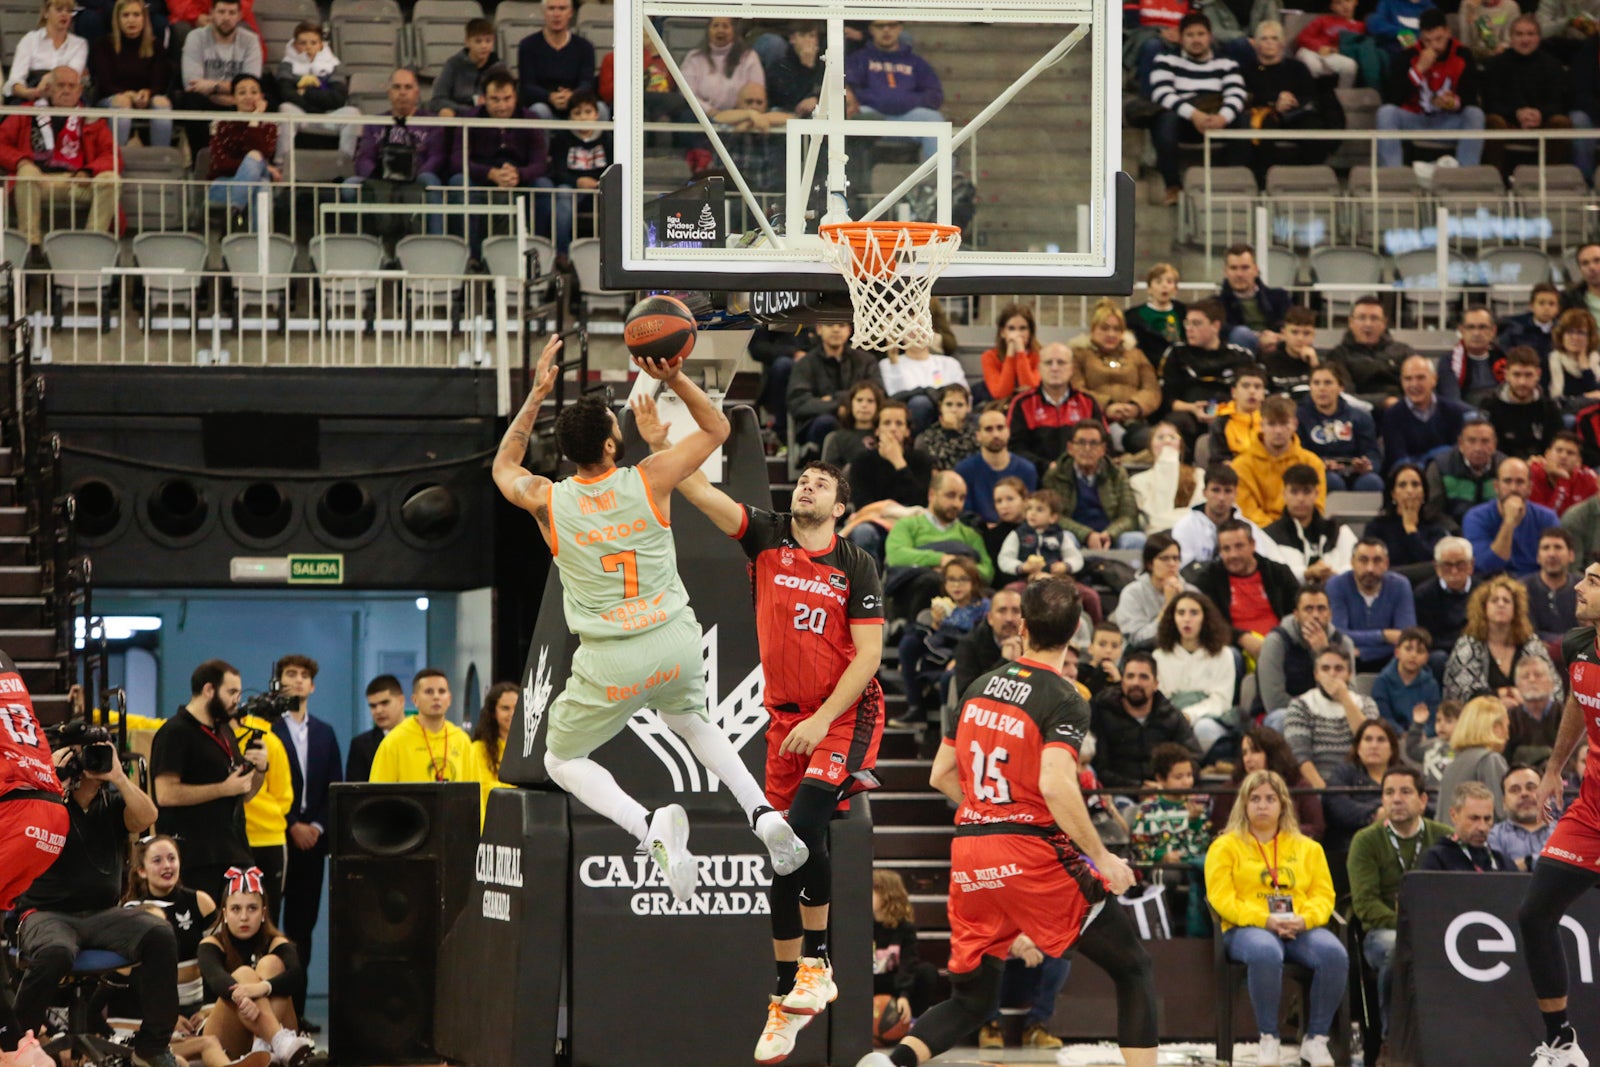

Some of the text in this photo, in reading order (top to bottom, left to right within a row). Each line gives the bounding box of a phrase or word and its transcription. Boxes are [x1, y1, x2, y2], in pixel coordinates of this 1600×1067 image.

[667, 228, 717, 240] Navidad
[575, 518, 648, 546] CAZOO
[292, 562, 338, 576] SALIDA
[600, 549, 639, 600] 7
[793, 602, 827, 635] 20
[0, 678, 25, 693] EVA
[983, 675, 1033, 705] COSTA
[0, 703, 39, 748] 13
[963, 704, 1025, 739] PULEVA
[969, 740, 1014, 805] 15
[475, 843, 524, 888] CAJA RURAL
[695, 855, 774, 888] RUR
[973, 863, 1024, 881] RURAL
[482, 889, 511, 922] GRANADA
[630, 892, 772, 916] GRANADA
